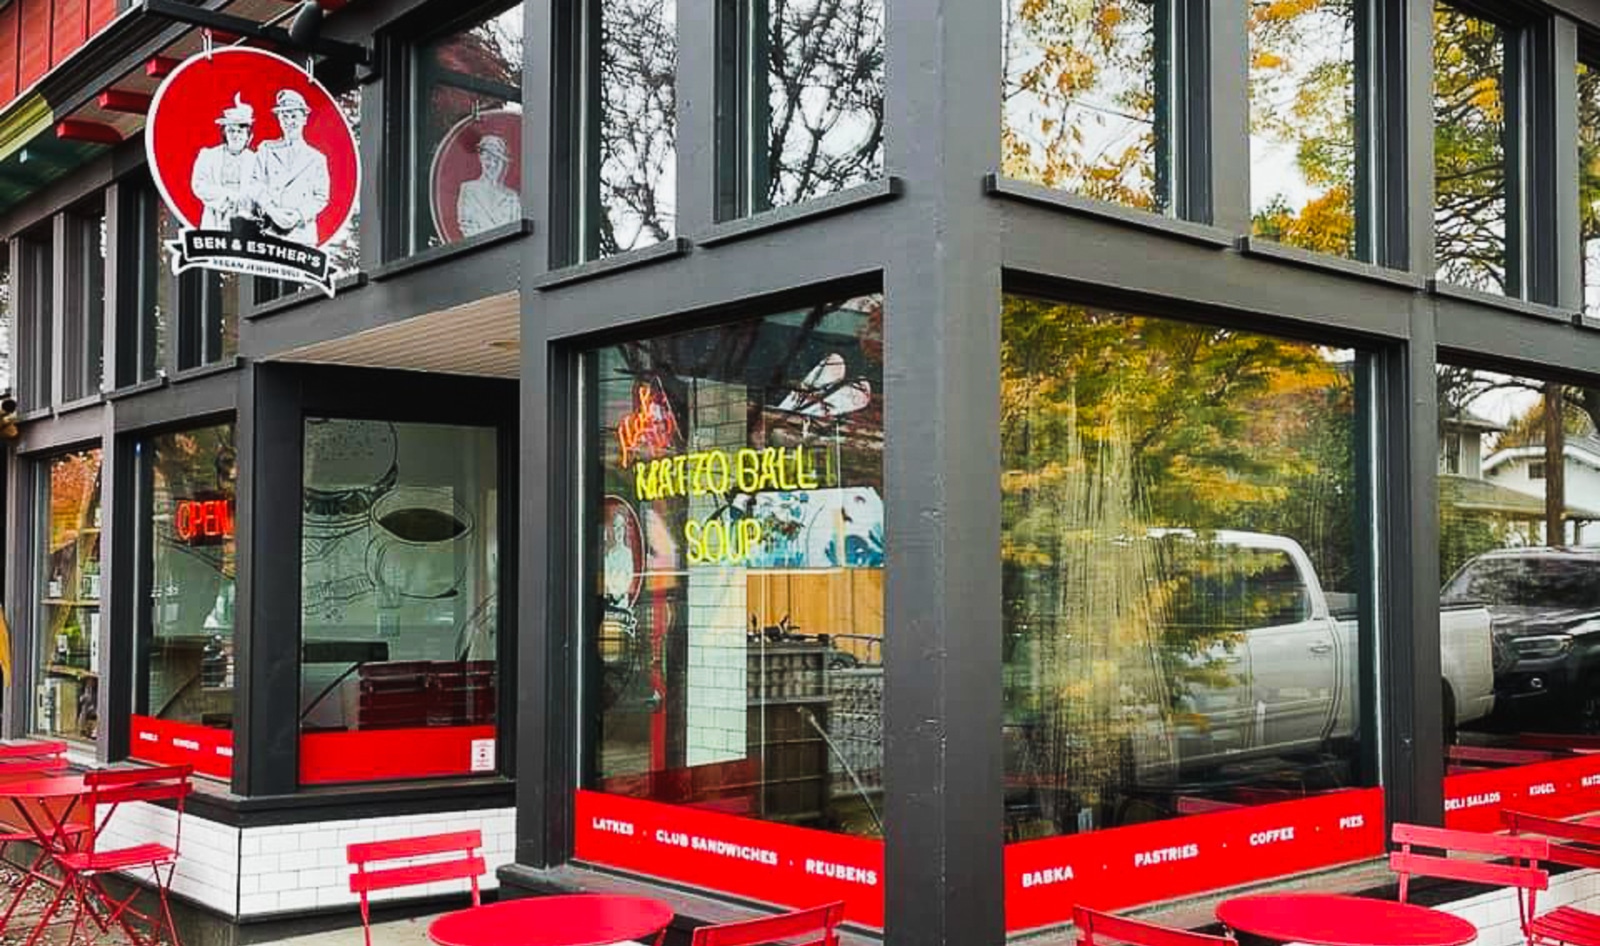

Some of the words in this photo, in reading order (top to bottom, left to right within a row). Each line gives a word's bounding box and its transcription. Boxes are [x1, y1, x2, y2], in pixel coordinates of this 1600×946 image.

[192, 236, 227, 250] BEN
[231, 239, 242, 251] &
[246, 240, 321, 268] ESTHER'S
[634, 449, 729, 500] MATZO
[737, 444, 819, 492] BALL
[176, 500, 234, 540] OPEN
[684, 518, 761, 563] SOUP
[1444, 798, 1465, 812] DELI
[1466, 792, 1501, 807] SALADS
[592, 816, 634, 836] LATKES
[655, 830, 688, 848] CLUB
[691, 836, 778, 866] SANDWICHES
[805, 858, 878, 886] REUBENS
[1022, 866, 1074, 888] BABKA
[1134, 844, 1199, 867] PASTRIES
[1249, 826, 1295, 846] COFFEE
[1339, 815, 1364, 829] PIES
